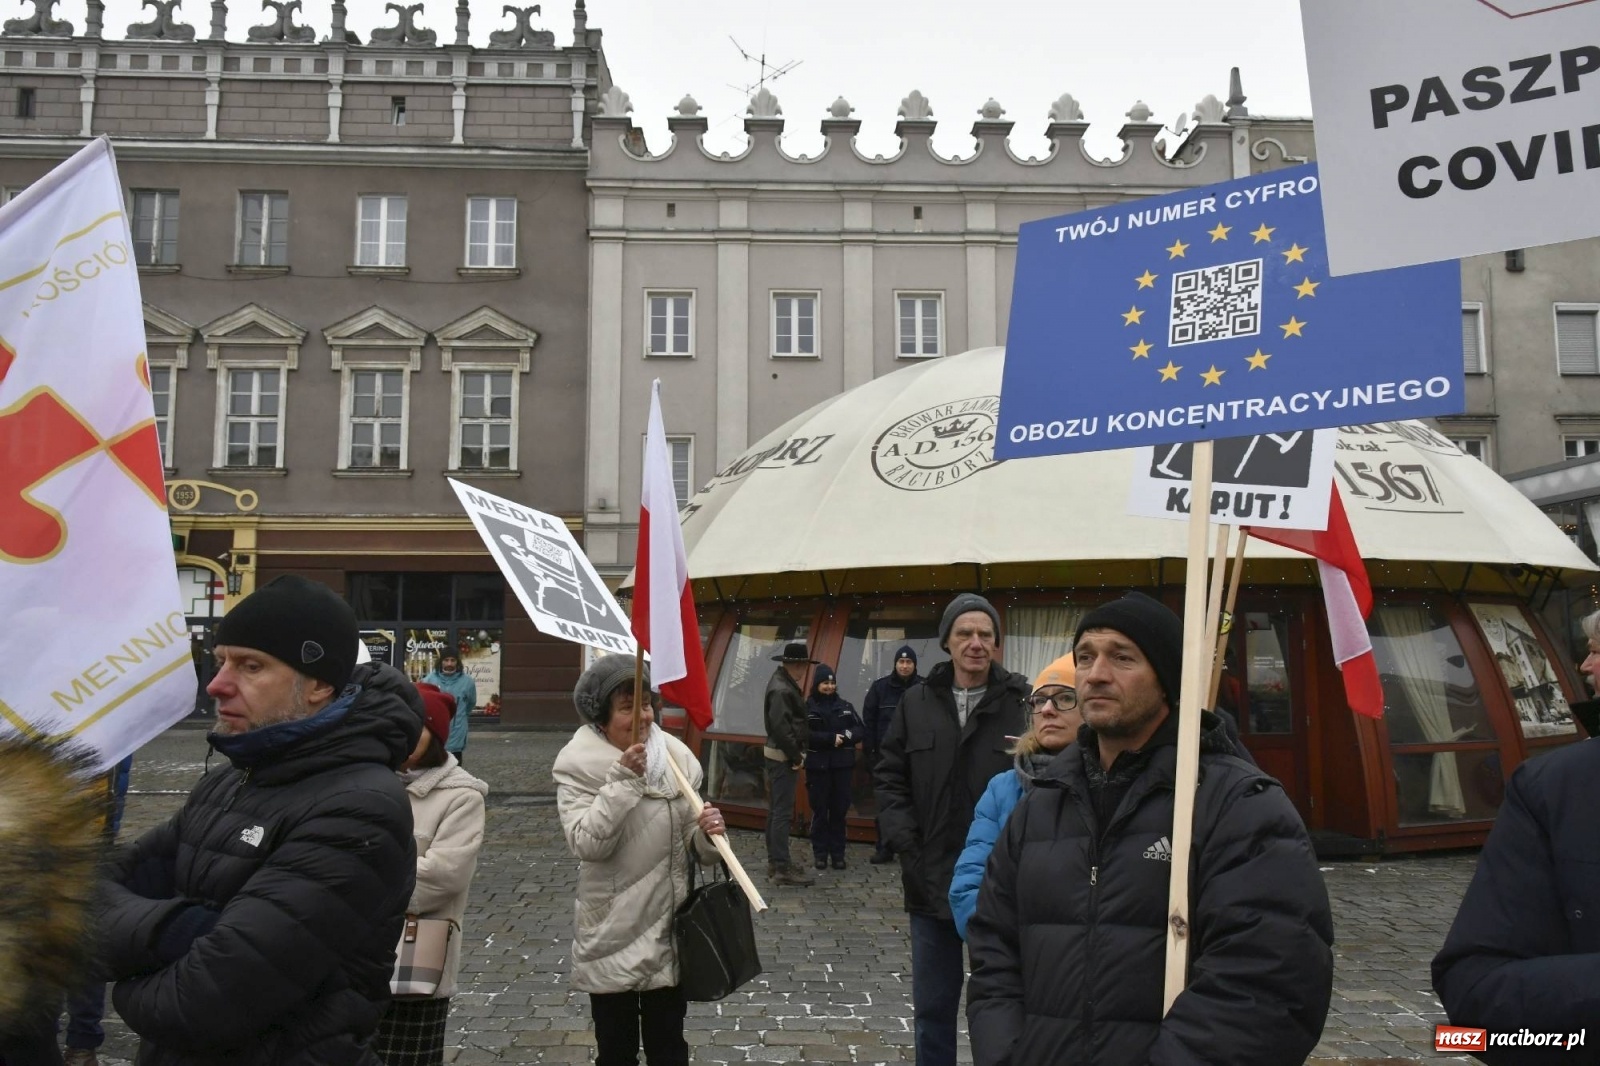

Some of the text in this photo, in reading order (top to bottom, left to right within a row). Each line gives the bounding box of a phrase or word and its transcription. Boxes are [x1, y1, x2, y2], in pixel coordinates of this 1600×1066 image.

[1370, 45, 1600, 129] PASZP
[1055, 176, 1318, 243] TWÓJ NUMER CYFRO
[889, 405, 953, 438] BROWAR
[1009, 376, 1451, 443] OBOZU KONCENTRACYJNEGO
[885, 451, 992, 487] RACIBÓRZ
[1334, 460, 1445, 506] 1567
[466, 490, 559, 533] MEDIA
[1166, 486, 1291, 520] KPUT!
[555, 620, 635, 653] KAPUT!
[50, 611, 188, 712] MENNIC
